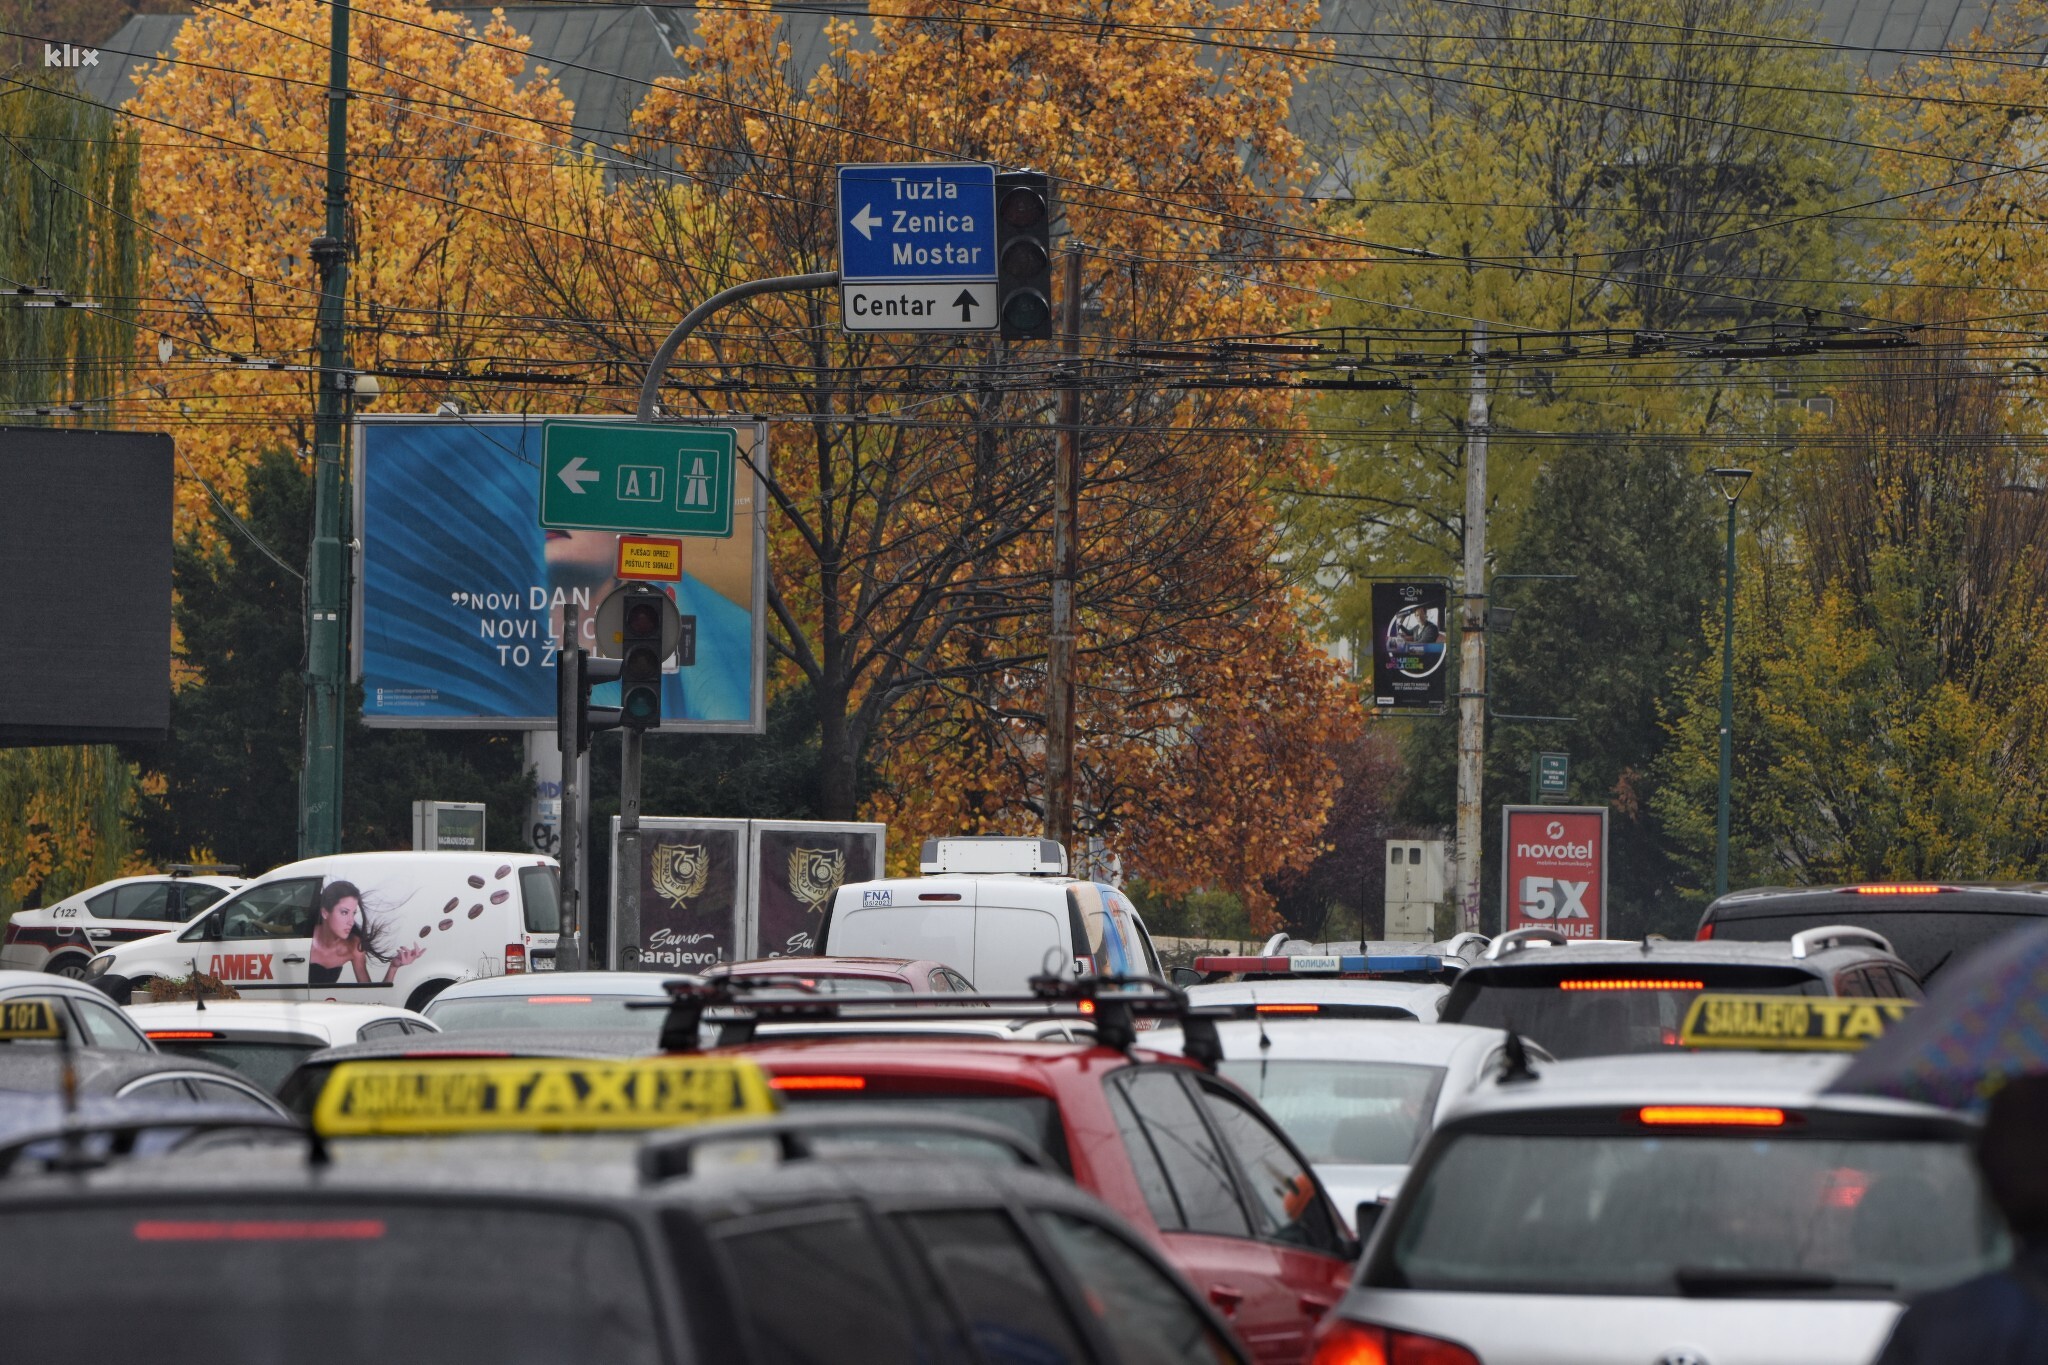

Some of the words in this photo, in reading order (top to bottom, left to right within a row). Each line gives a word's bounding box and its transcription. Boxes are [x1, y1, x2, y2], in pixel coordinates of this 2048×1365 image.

[891, 177, 958, 200] Tuzla
[892, 210, 975, 233] Zenica
[892, 242, 982, 265] Mostar
[852, 293, 936, 316] Centar
[625, 559, 651, 569] POŠTUJTE
[652, 561, 675, 570] SIGNALE!
[652, 550, 671, 558] OPREZ!
[480, 619, 537, 639] NOVI
[496, 645, 531, 667] TO
[1517, 840, 1593, 859] novotel
[864, 890, 891, 900] FNA
[1519, 876, 1590, 920] 5X
[60, 908, 77, 918] 122
[650, 928, 714, 949] Samo
[209, 954, 273, 980] AMEX
[492, 1071, 656, 1114] TAXI
